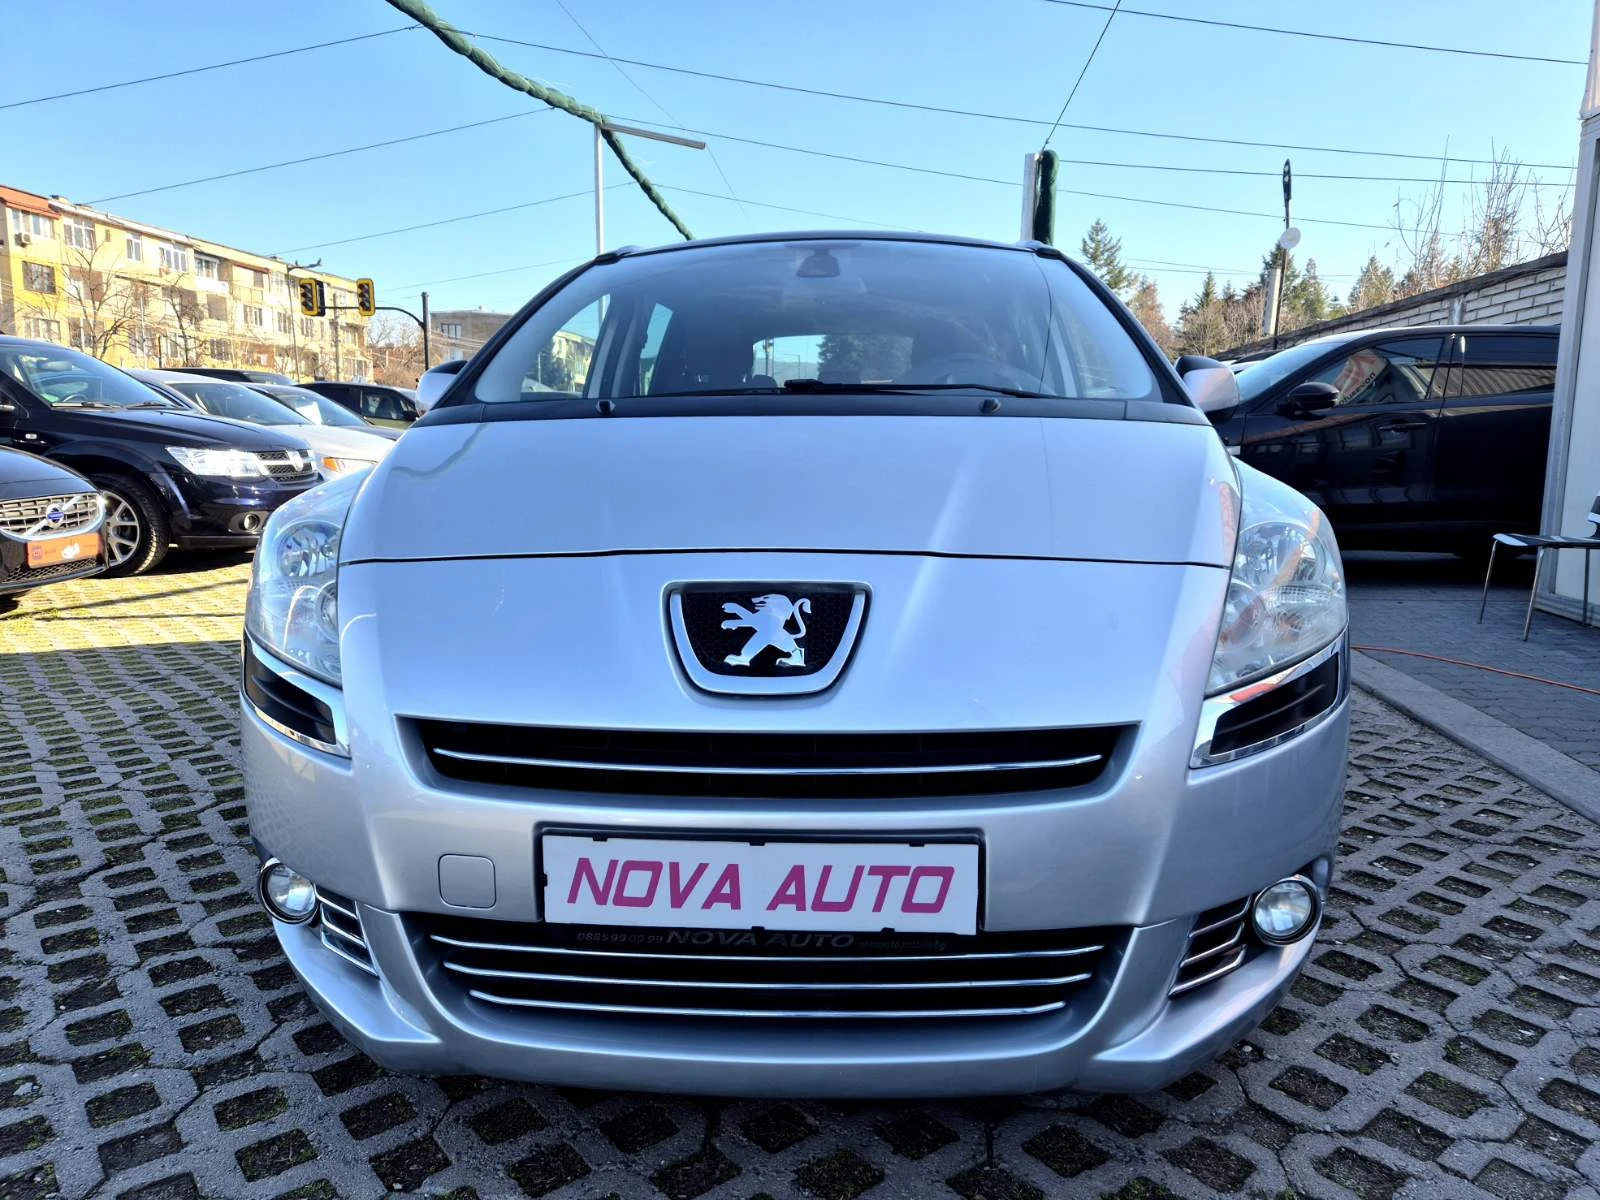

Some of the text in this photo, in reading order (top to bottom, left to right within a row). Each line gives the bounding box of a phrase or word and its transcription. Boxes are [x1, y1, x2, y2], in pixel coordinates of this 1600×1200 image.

[567, 857, 955, 914] NOVA AUTO
[666, 929, 758, 946] NOVA
[766, 933, 855, 948] AUTO
